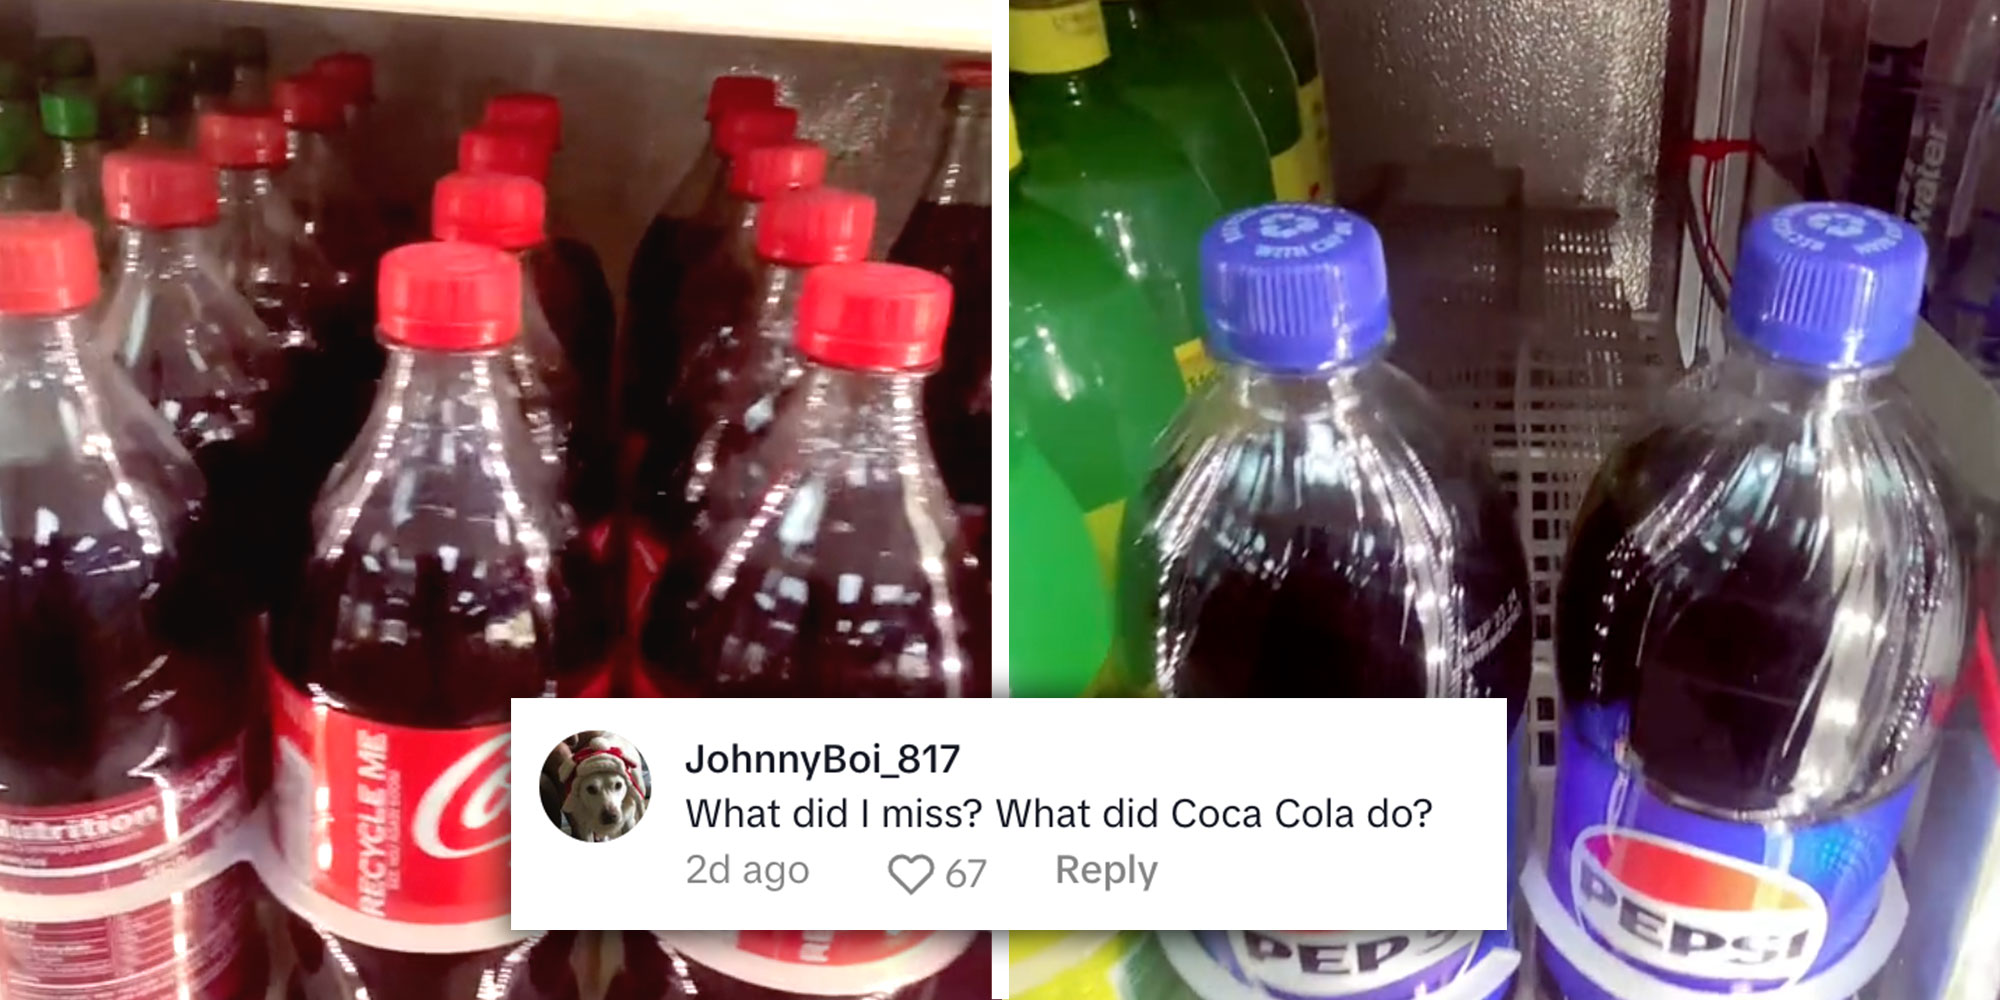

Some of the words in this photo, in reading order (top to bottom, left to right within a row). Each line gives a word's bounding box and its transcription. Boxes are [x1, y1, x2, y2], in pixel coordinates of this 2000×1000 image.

[1910, 121, 1948, 233] water
[356, 728, 388, 781] ME
[356, 783, 388, 919] RECYCLE
[1578, 866, 1808, 964] PEPSI
